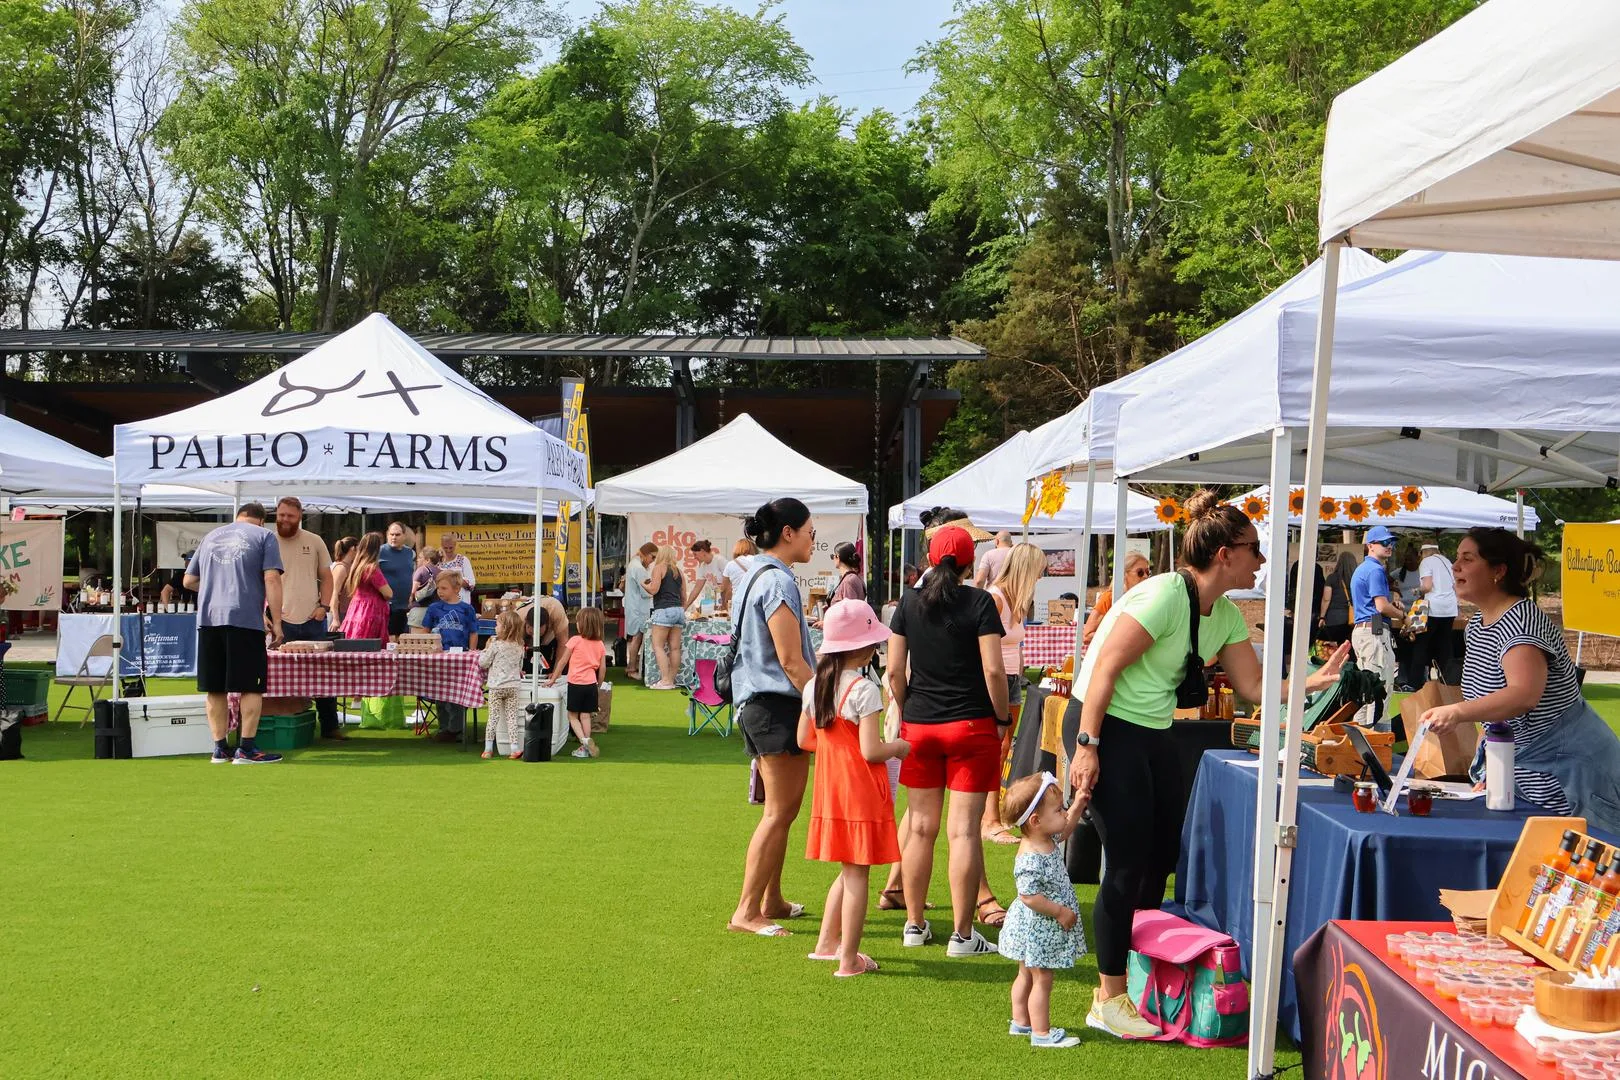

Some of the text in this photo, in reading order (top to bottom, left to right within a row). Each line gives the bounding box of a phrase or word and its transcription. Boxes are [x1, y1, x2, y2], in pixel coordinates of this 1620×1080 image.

[148, 431, 508, 472] PALEO FARMS
[469, 530, 482, 540] La
[484, 530, 511, 541] Vega
[513, 528, 555, 539] Torlla
[652, 525, 697, 547] eko
[1566, 547, 1620, 584] Ballantyne Ba
